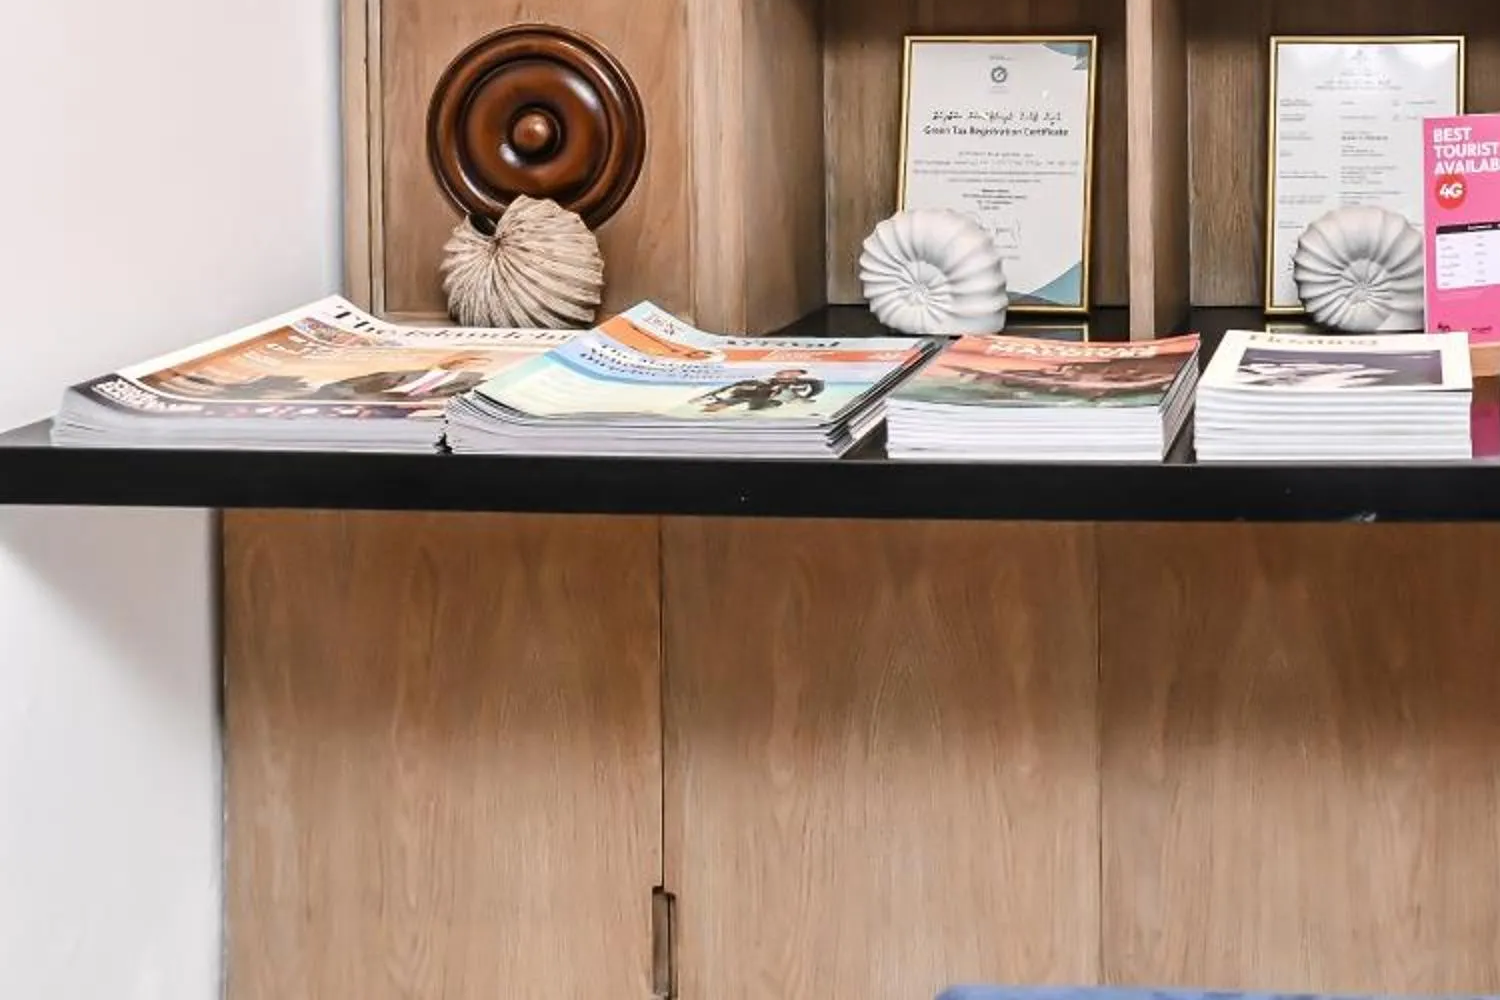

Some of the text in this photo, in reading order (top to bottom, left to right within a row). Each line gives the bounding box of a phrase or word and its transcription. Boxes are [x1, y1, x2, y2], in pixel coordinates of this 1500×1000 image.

[923, 125, 1069, 138] Green Tax Registration Certificate
[1433, 126, 1473, 143] BEST
[1433, 140, 1500, 159] TOURIST
[1439, 182, 1464, 198] 4G
